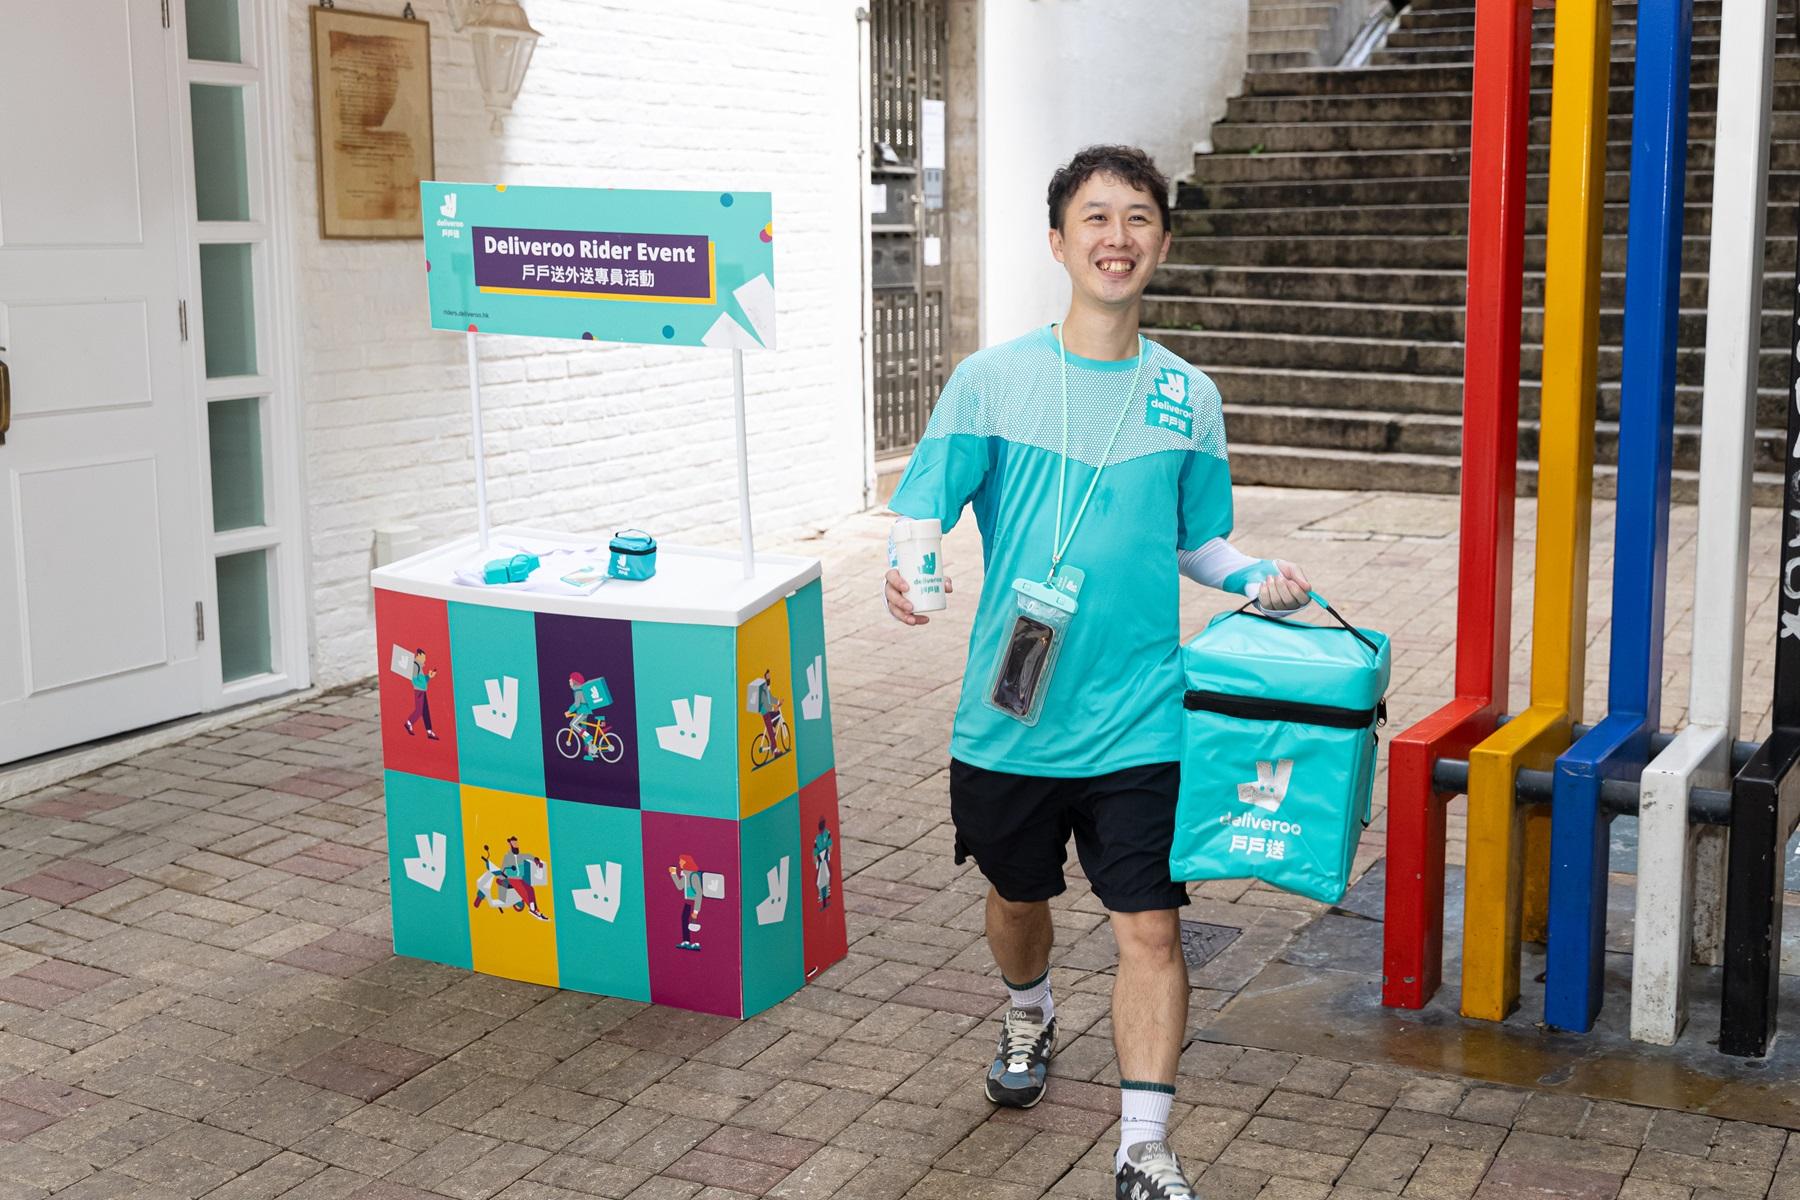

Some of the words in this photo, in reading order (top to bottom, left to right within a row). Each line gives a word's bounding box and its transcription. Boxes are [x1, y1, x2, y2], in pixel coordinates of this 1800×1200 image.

[484, 235, 575, 257] Deliveroo
[580, 240, 632, 260] Rider
[637, 243, 696, 263] Event
[1219, 811, 1302, 836] deliveroo
[1229, 834, 1285, 860] 戶戶送
[1145, 1142, 1165, 1153] 990
